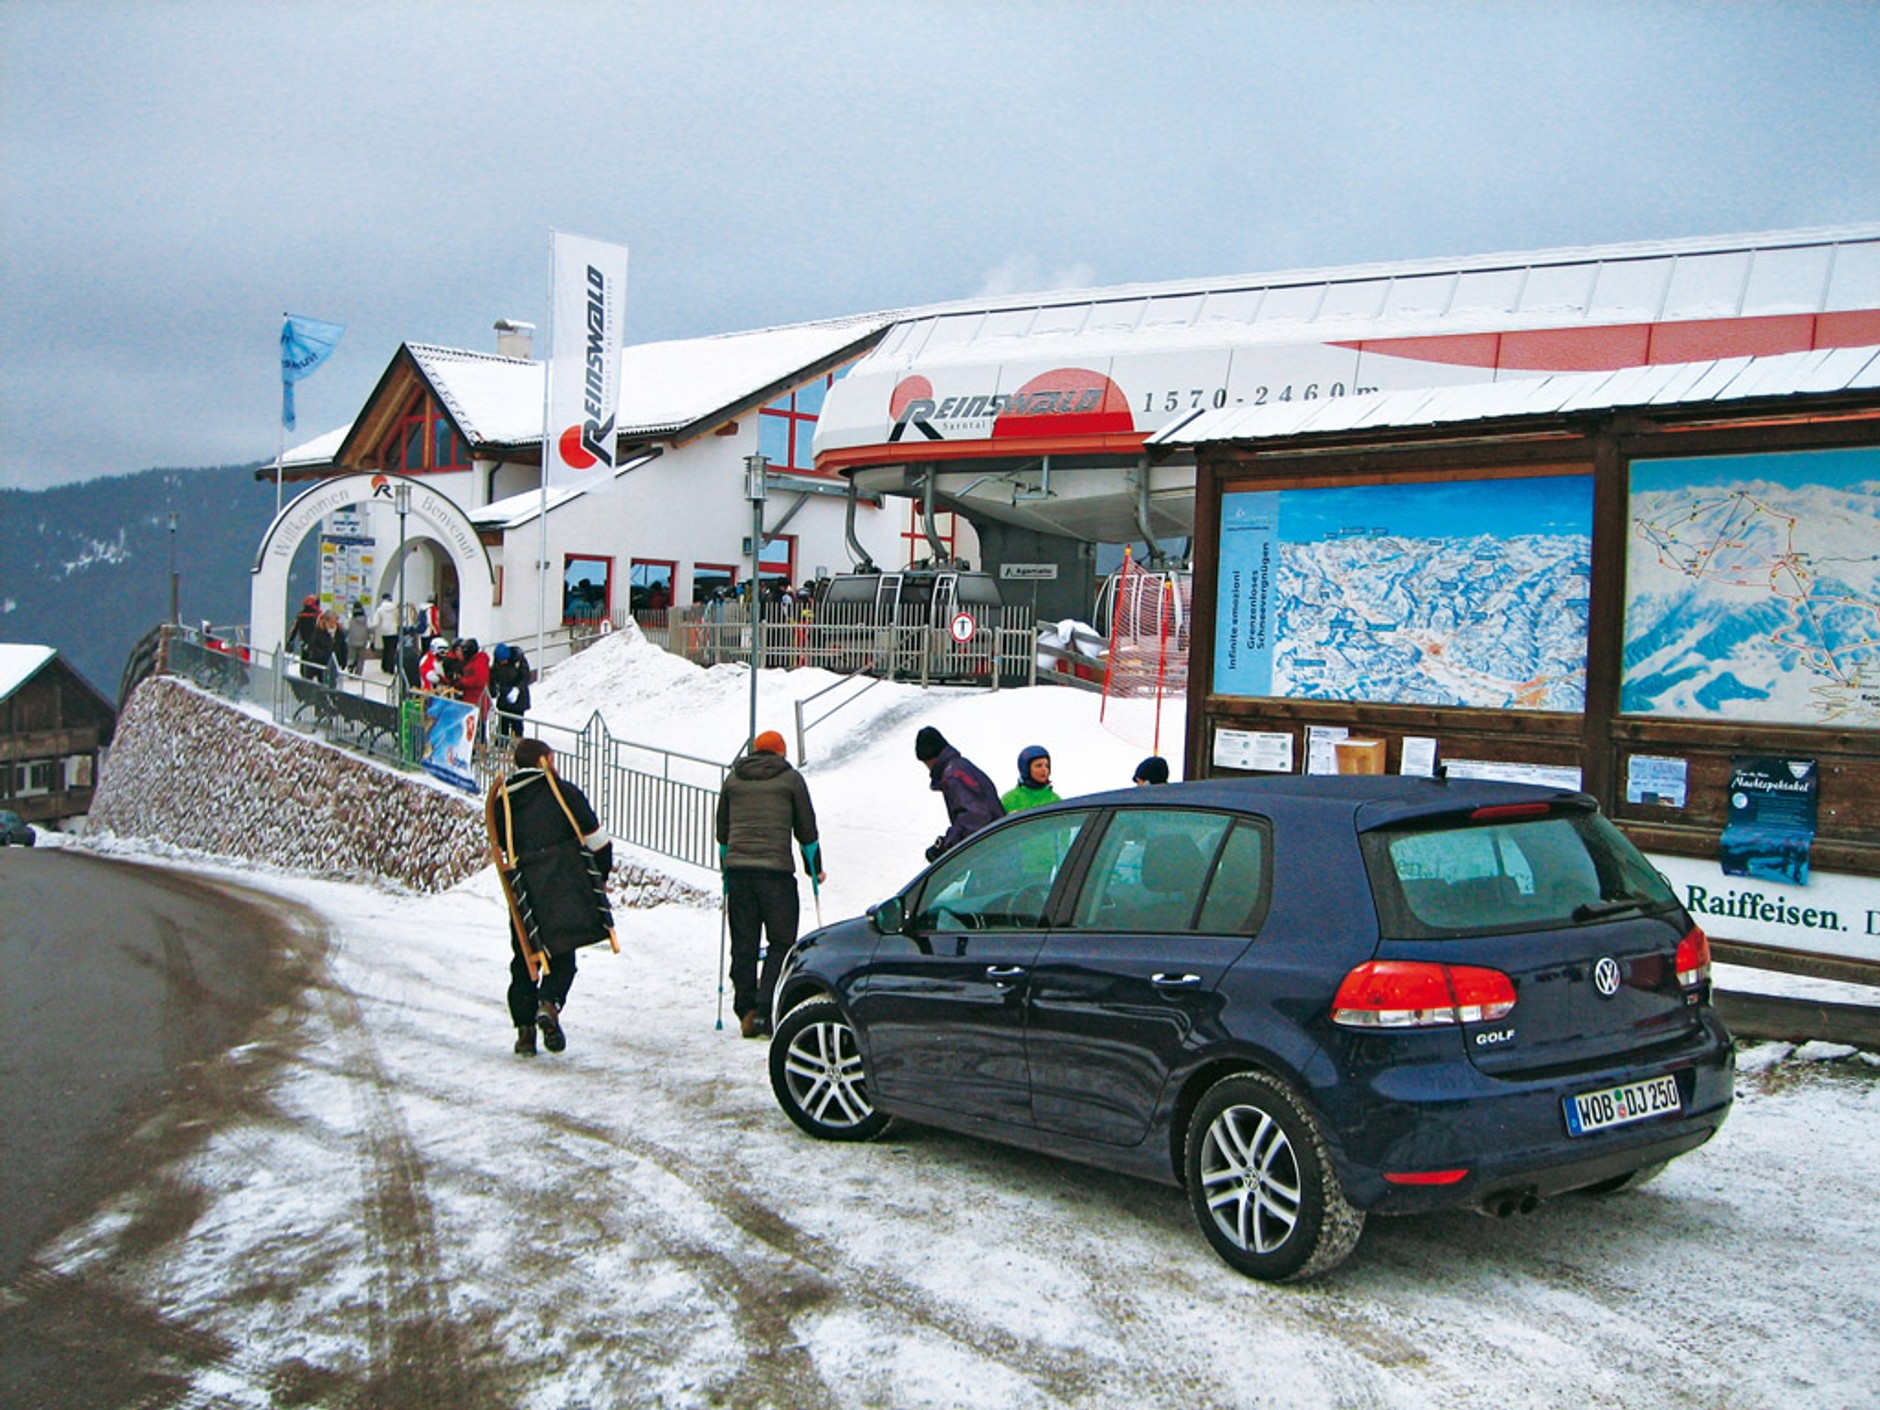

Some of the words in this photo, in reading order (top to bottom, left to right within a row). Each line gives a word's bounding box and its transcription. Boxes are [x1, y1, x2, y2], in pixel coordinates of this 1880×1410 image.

[942, 421, 986, 431] Sarntal
[273, 490, 350, 557] Willkommen
[1230, 570, 1241, 625] emozioni
[1247, 570, 1259, 650] Grenzenloses
[1257, 541, 1270, 650] Schneevergnügen
[1228, 627, 1239, 670] Infinite
[1686, 885, 1849, 932] Raiffeisen.
[1476, 1029, 1516, 1045] GOLF
[1578, 1094, 1614, 1127] WOB
[1624, 1086, 1648, 1116] DJ
[1648, 1080, 1678, 1111] 250
